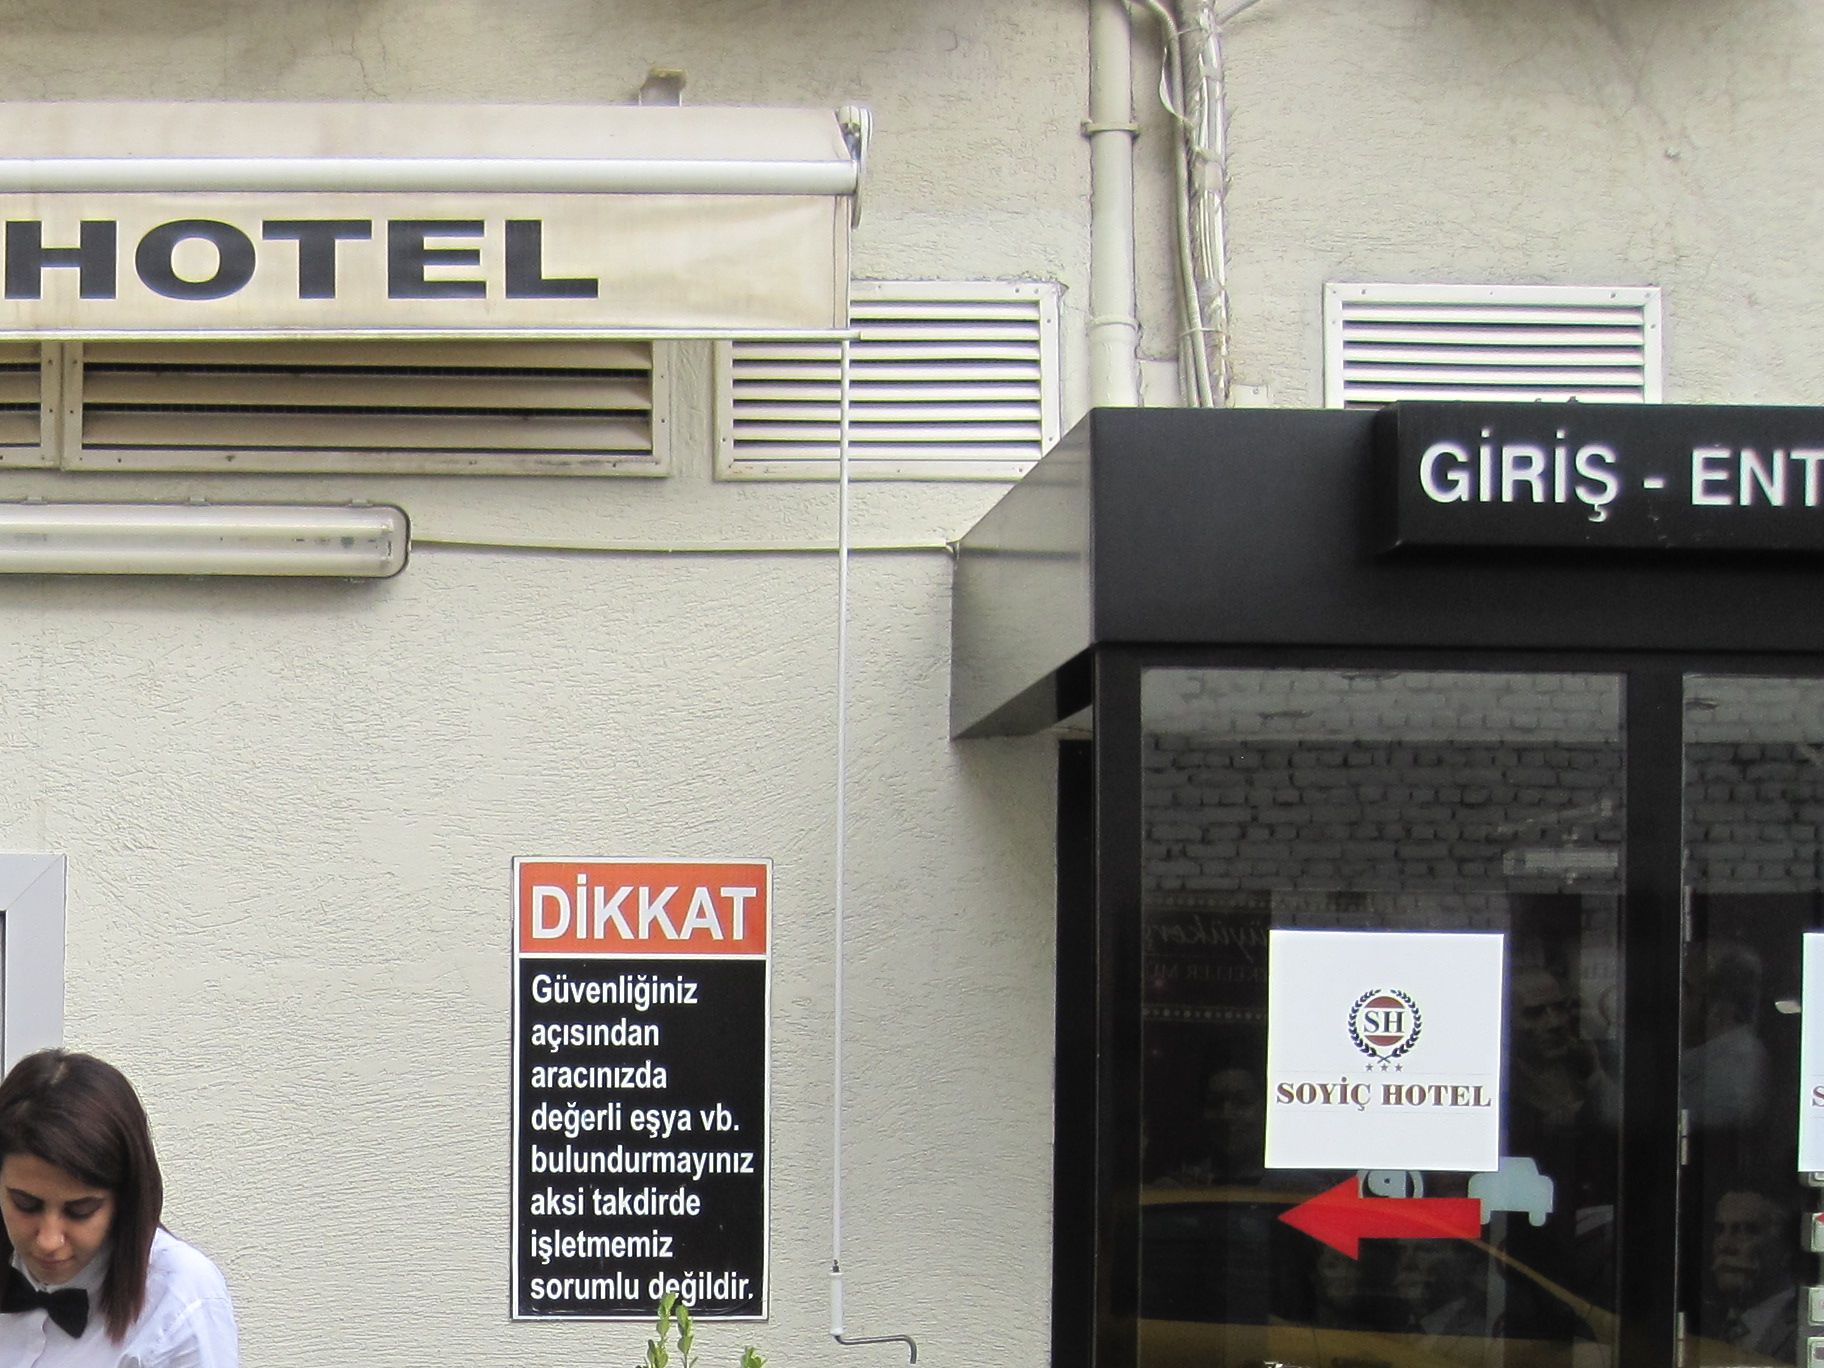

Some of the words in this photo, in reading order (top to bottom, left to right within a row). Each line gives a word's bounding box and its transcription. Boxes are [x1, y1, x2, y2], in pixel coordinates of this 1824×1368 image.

[4, 217, 600, 301] HOTEL
[1420, 428, 1619, 522] GİRİŞ
[1642, 477, 1665, 490] -
[531, 873, 757, 940] DİKKAT
[531, 973, 698, 1011] Güvenliğiniz
[531, 1018, 660, 1052] açısından
[1363, 1010, 1406, 1034] SH
[531, 1060, 667, 1089] aracınızda
[1276, 1076, 1372, 1111] SOYİÇ
[1381, 1083, 1492, 1107] HOTEL
[531, 1102, 622, 1138] değerli
[630, 1108, 691, 1138] eşya
[699, 1103, 740, 1131] vb.
[531, 1145, 754, 1181] bulundurmayınız
[530, 1187, 585, 1216] aksi
[592, 1187, 701, 1216] takdirde
[530, 1229, 673, 1264] işletmemiz
[530, 1271, 640, 1300] sorumlu
[648, 1270, 754, 1306] değildir.
